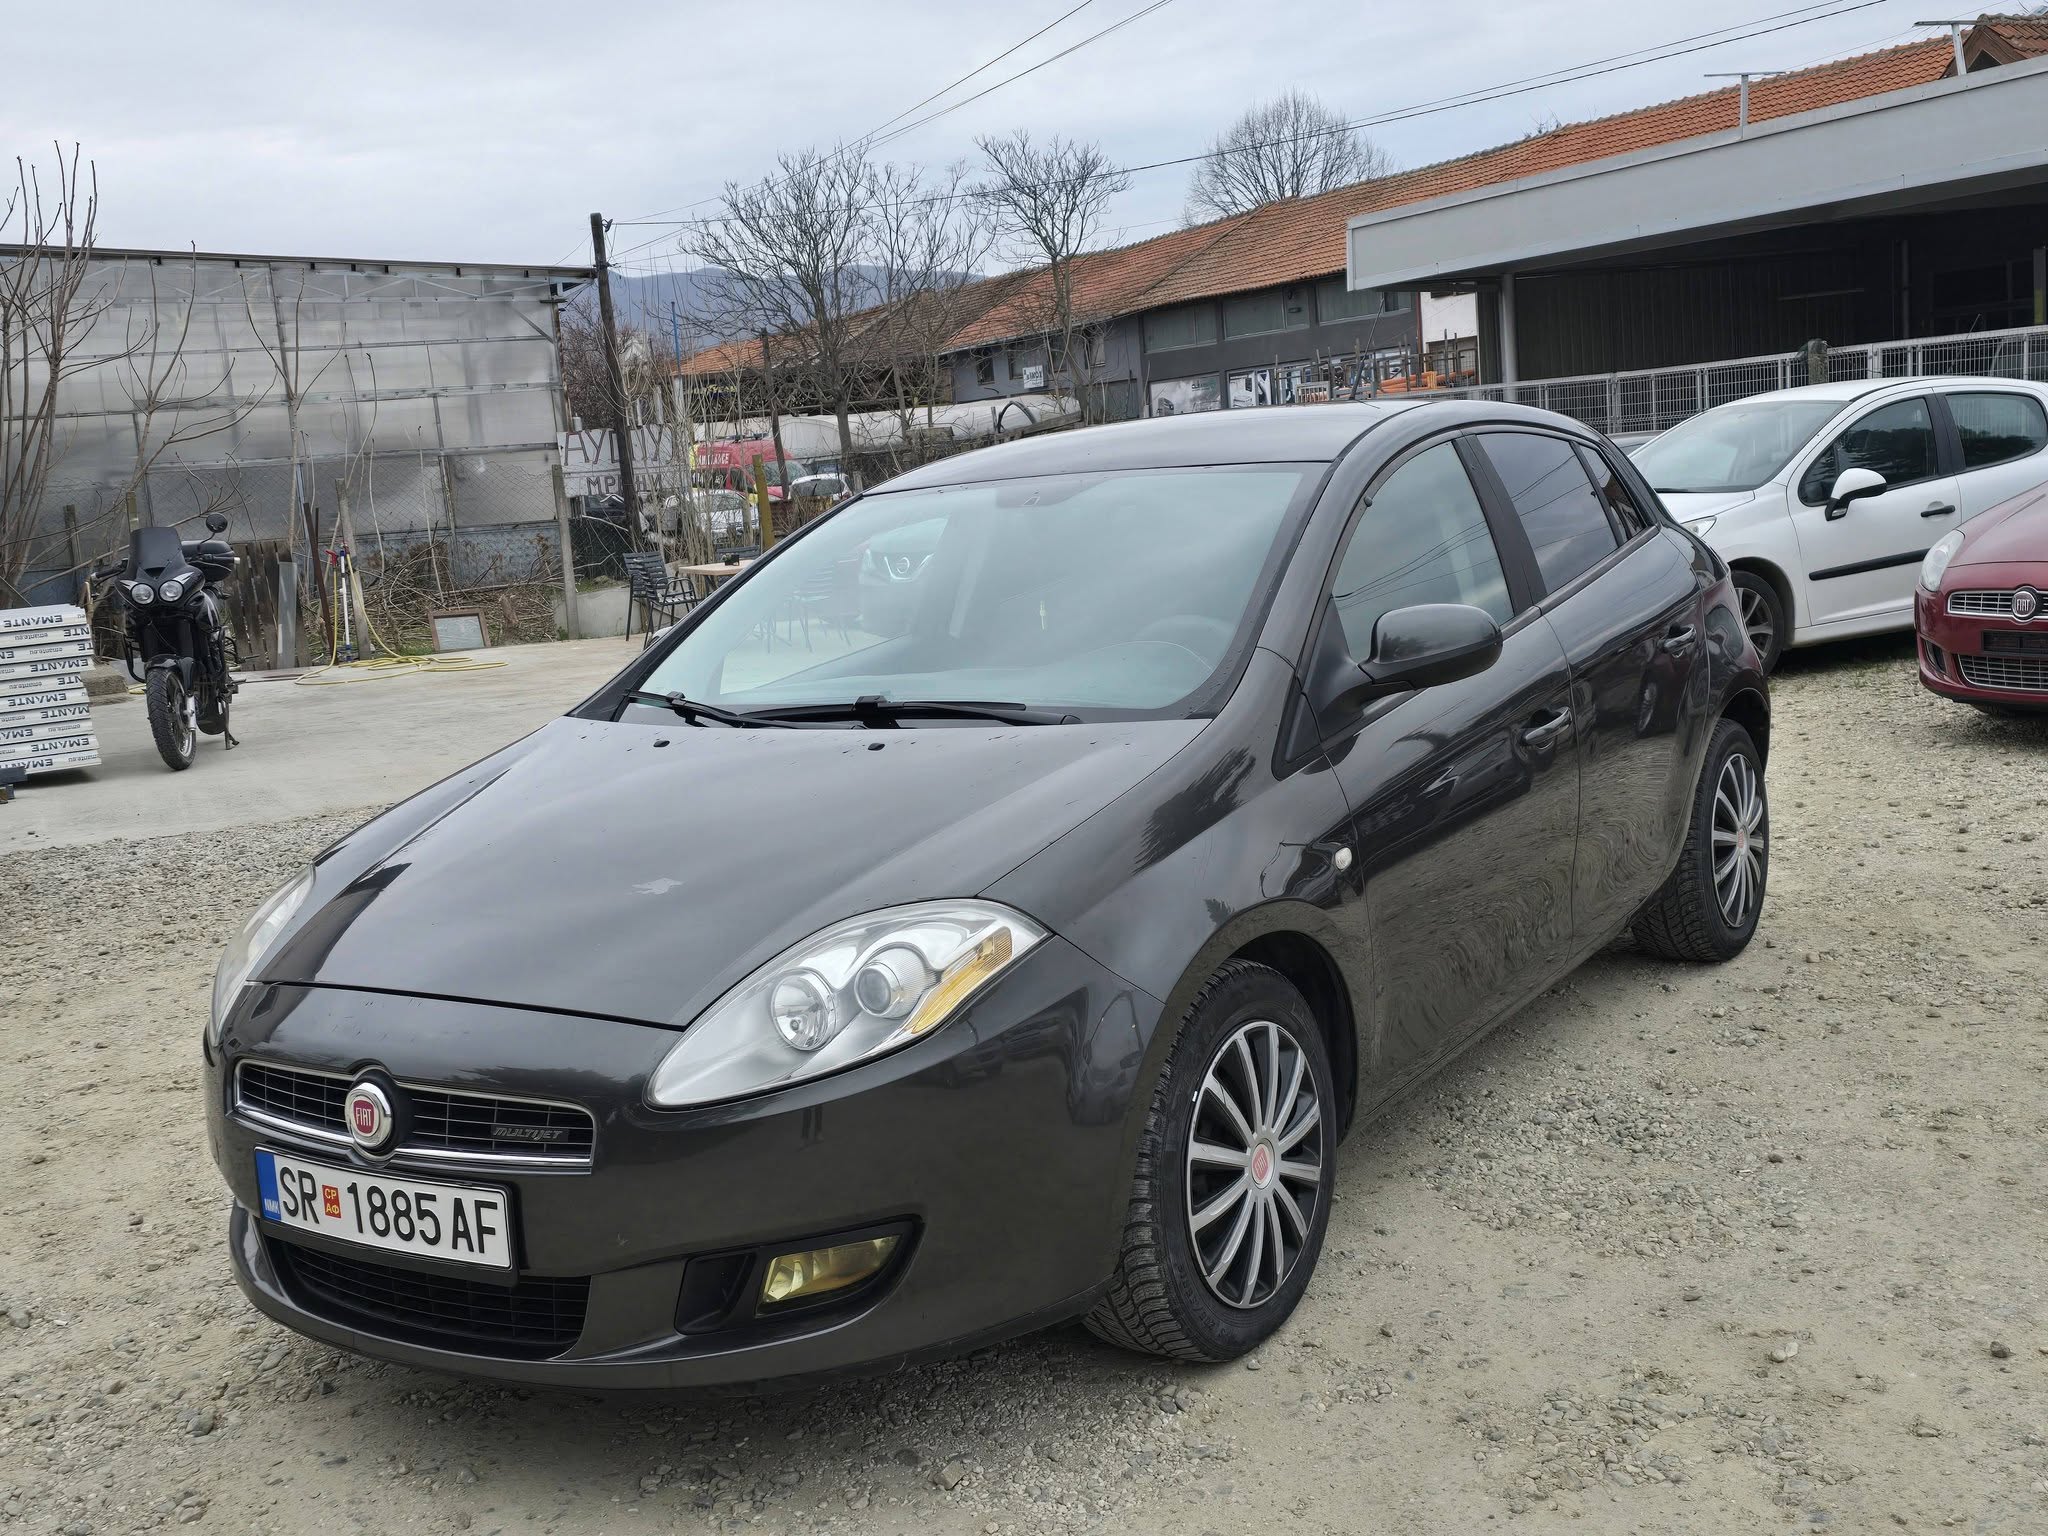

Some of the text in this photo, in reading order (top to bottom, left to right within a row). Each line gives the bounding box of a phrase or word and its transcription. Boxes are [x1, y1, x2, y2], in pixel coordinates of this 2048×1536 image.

[2016, 598, 2031, 612] FIAT
[4, 615, 63, 628] EMANTE
[30, 659, 89, 673] EMANTE
[7, 692, 67, 707] EMANTE
[31, 737, 90, 752] EMANTE
[355, 1107, 372, 1127] FIAT
[493, 1127, 563, 1141] MULTIJET
[264, 1198, 281, 1215] NMK
[280, 1166, 498, 1254] SR 1885 AF
[325, 1203, 340, 1216] АФ
